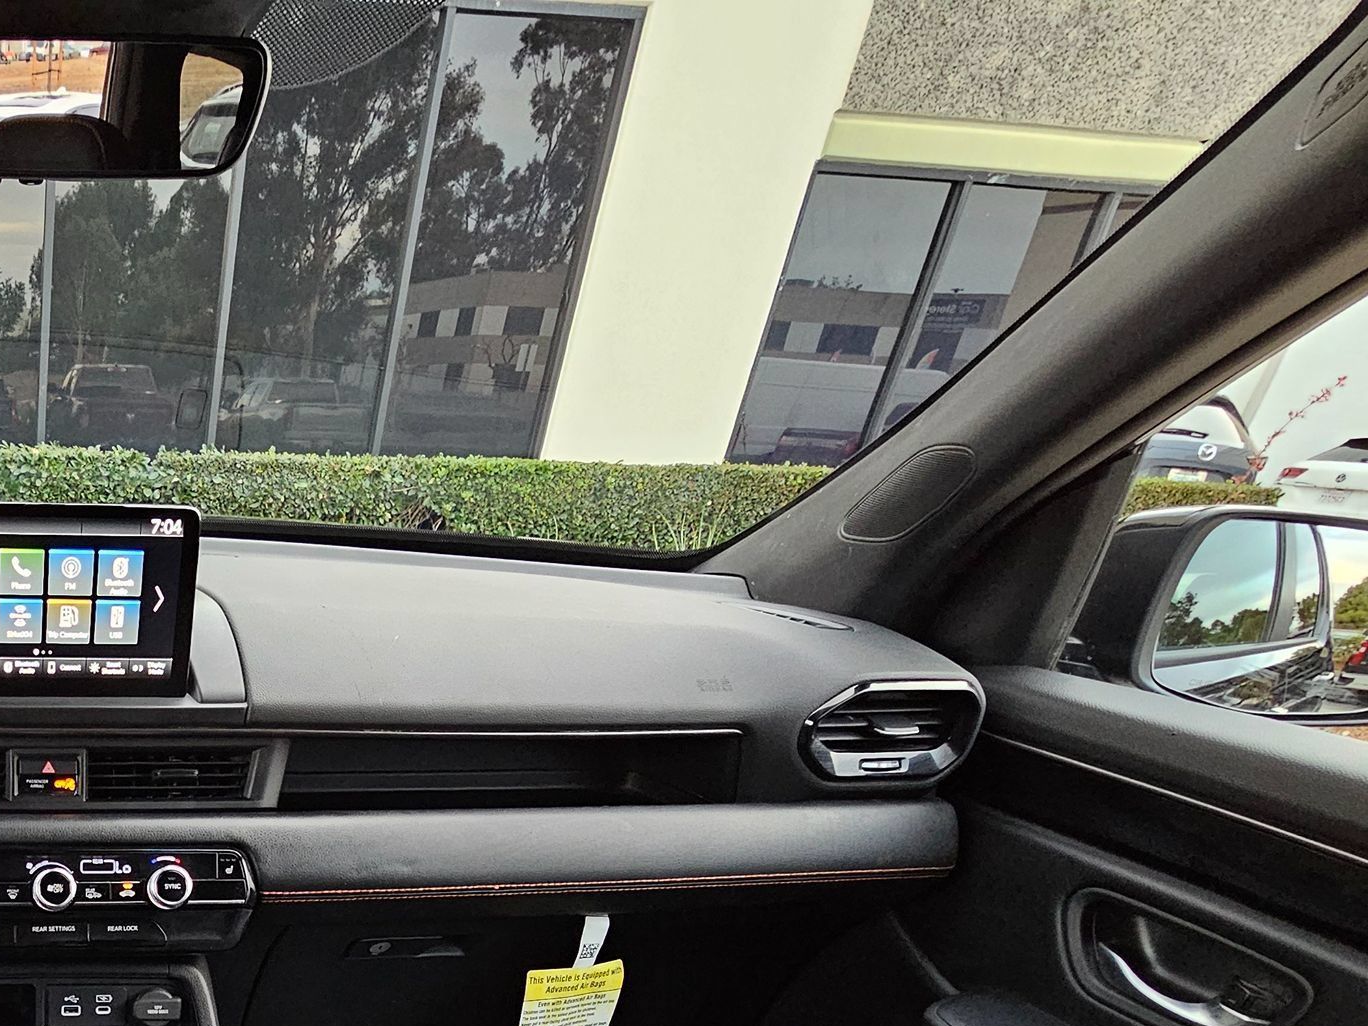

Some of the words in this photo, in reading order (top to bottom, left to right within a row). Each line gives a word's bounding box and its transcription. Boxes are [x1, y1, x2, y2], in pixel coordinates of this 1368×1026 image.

[151, 518, 182, 535] 7:04
[529, 976, 544, 984] This
[546, 975, 572, 983] Vehicle
[581, 968, 610, 980] Equipped
[611, 967, 622, 975] with
[545, 984, 578, 994] Advanced
[579, 982, 589, 990] Air
[589, 980, 607, 989] Bags
[563, 996, 587, 1005] Advanced
